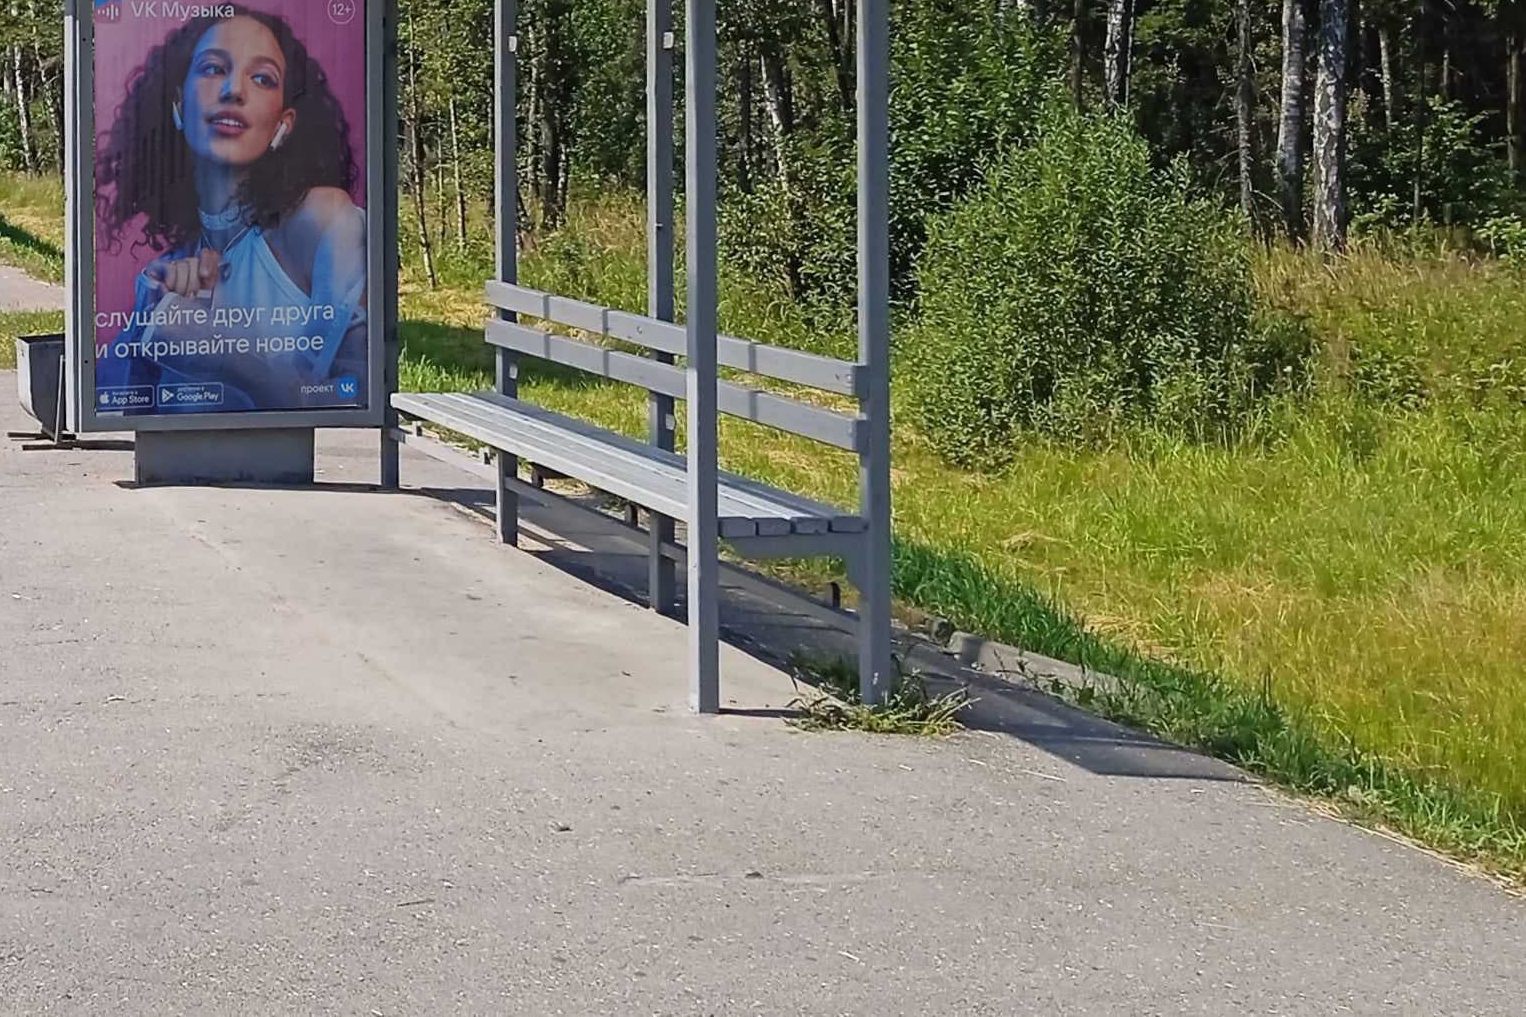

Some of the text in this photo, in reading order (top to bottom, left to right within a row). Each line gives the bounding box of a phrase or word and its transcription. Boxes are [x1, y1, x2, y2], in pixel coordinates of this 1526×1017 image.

[130, 0, 235, 21] VK Музыка
[332, 2, 352, 16] 12+
[95, 304, 335, 330] слушайте друг друга
[95, 334, 324, 360] и открывайте новое
[300, 384, 334, 395] проект
[340, 382, 354, 393] VK
[111, 394, 150, 405] App Store
[176, 390, 219, 402] Google Play
